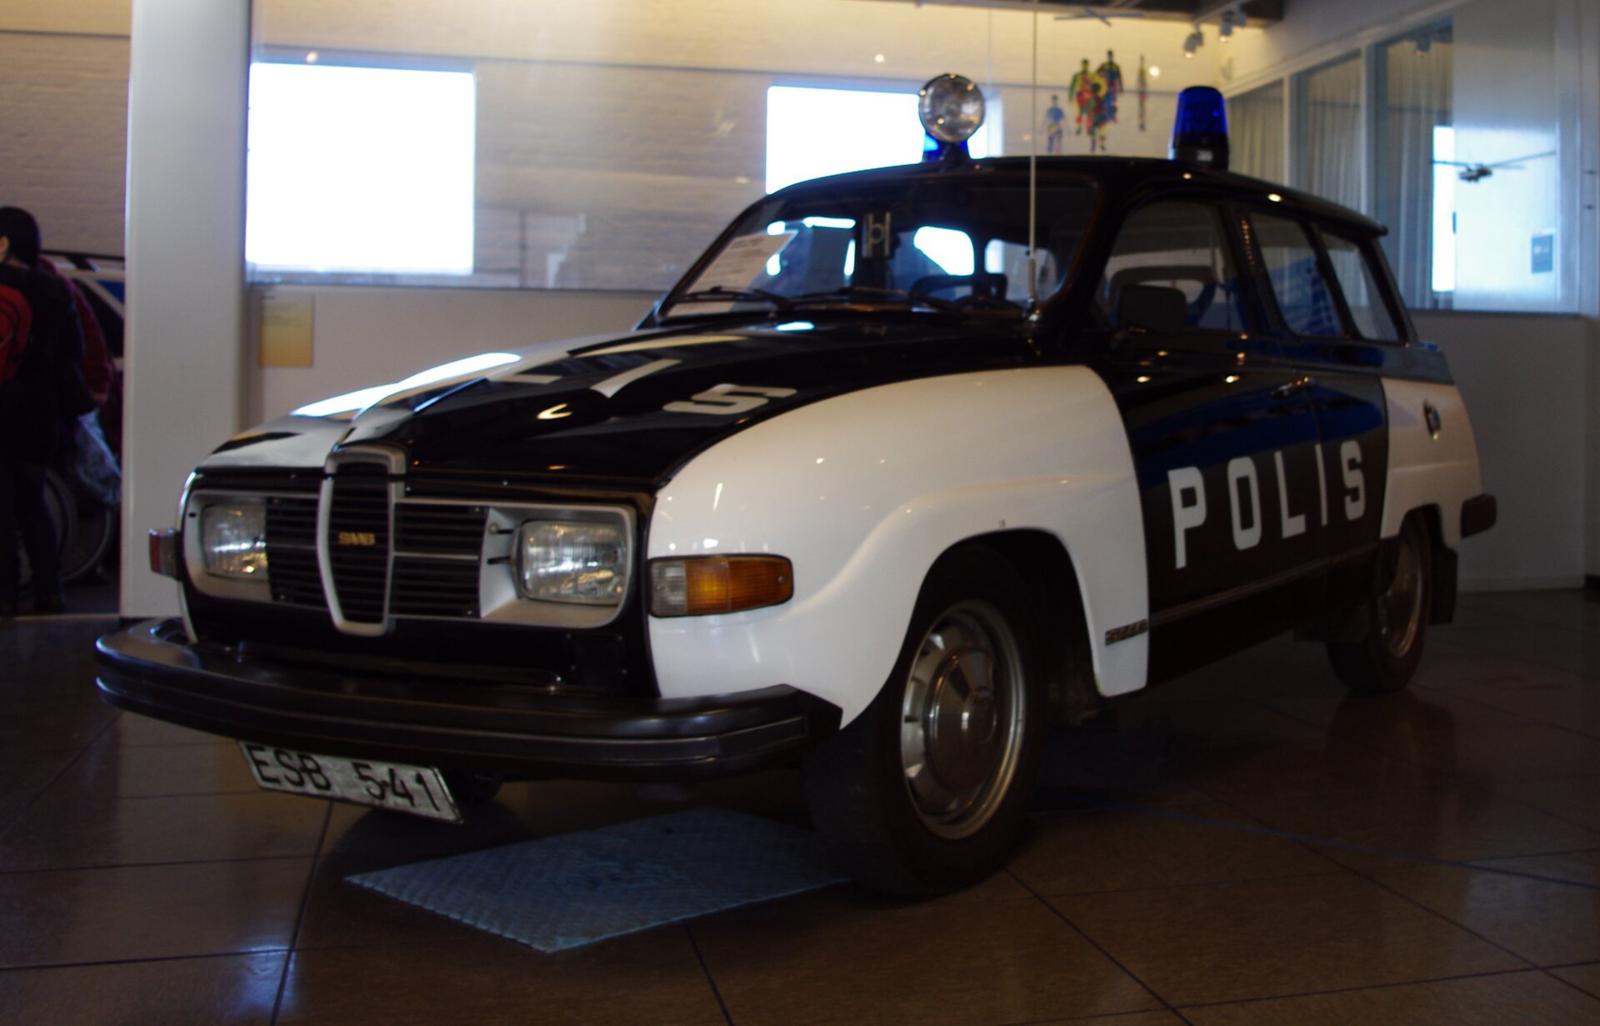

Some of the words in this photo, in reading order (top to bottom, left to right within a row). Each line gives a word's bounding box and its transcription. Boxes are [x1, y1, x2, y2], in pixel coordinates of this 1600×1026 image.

[1167, 439, 1367, 570] POLIS
[246, 744, 331, 790] ESB
[353, 762, 440, 811] 541
